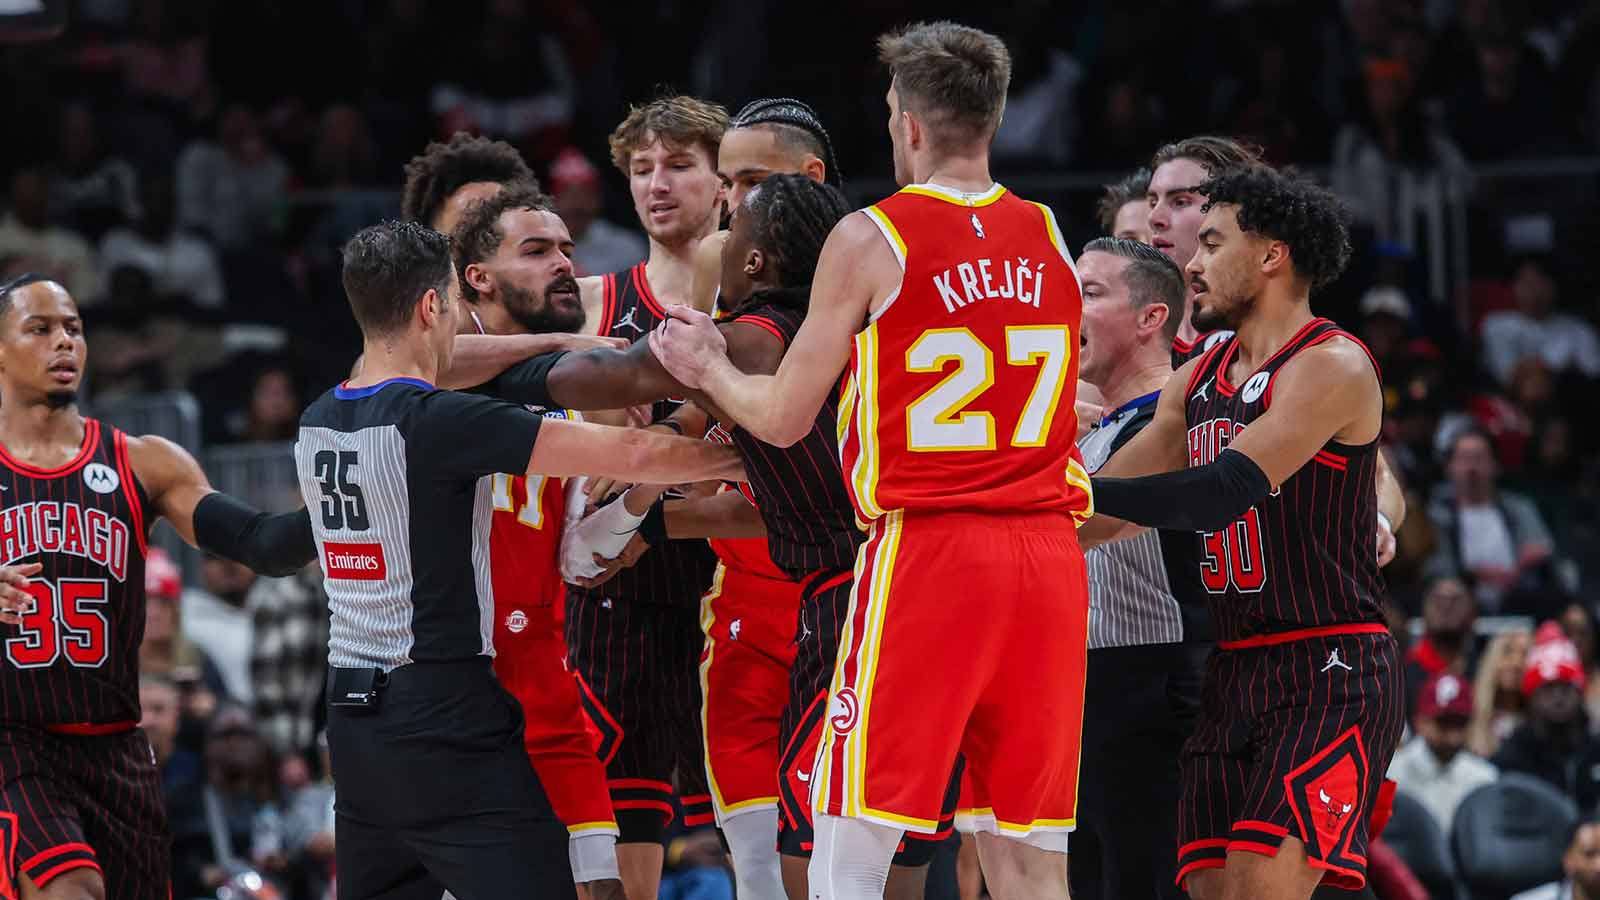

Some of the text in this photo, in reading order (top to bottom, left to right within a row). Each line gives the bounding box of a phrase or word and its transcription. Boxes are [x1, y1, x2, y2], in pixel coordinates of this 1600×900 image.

[933, 257, 1046, 314] KREJČÍ
[904, 324, 1071, 452] 27
[314, 450, 370, 531] 35
[327, 551, 379, 570] Emirates
[1196, 506, 1267, 594] 30
[6, 577, 109, 669] 35
